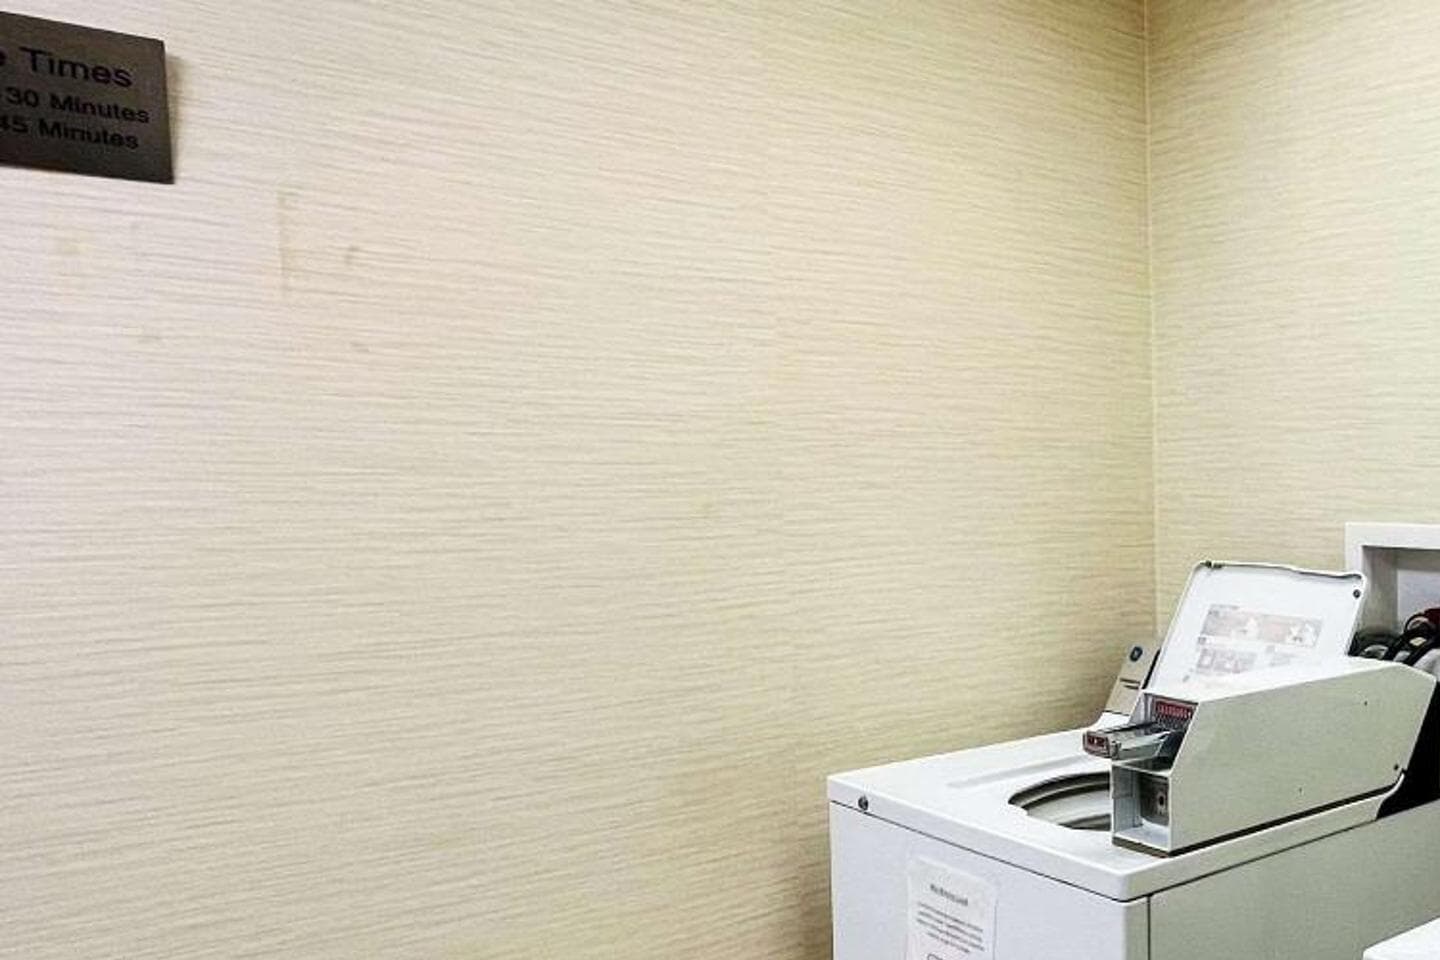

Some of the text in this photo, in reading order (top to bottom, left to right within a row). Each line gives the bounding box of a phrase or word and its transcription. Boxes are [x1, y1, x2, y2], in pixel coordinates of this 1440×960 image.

[19, 46, 133, 88] Times
[5, 86, 149, 124] 30 Minutes
[39, 117, 139, 150] Minutes
